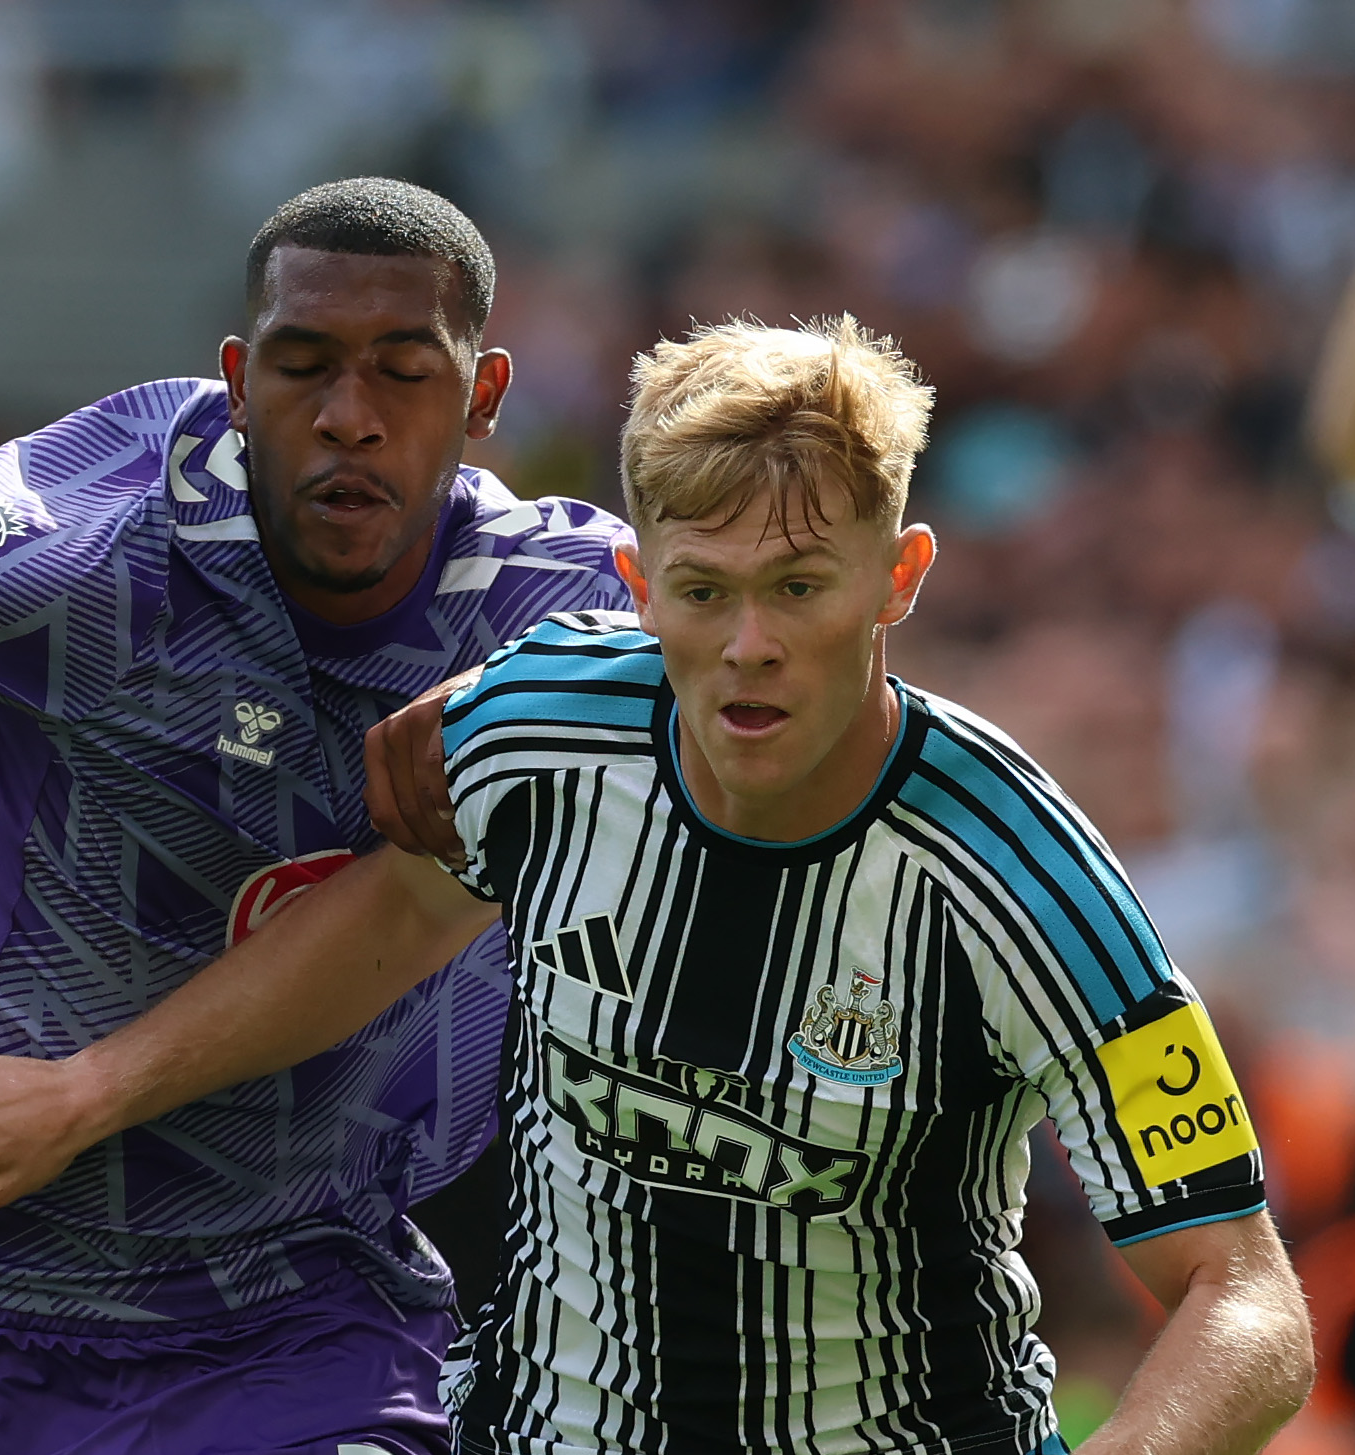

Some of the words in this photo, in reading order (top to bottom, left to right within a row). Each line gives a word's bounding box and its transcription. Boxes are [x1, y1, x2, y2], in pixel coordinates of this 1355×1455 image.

[216, 734, 274, 766] hummel
[801, 1054, 851, 1081] NEWCASTLE
[852, 1072, 885, 1083] UNITED
[547, 1041, 857, 1206] KNOX
[1138, 1093, 1248, 1158] noon
